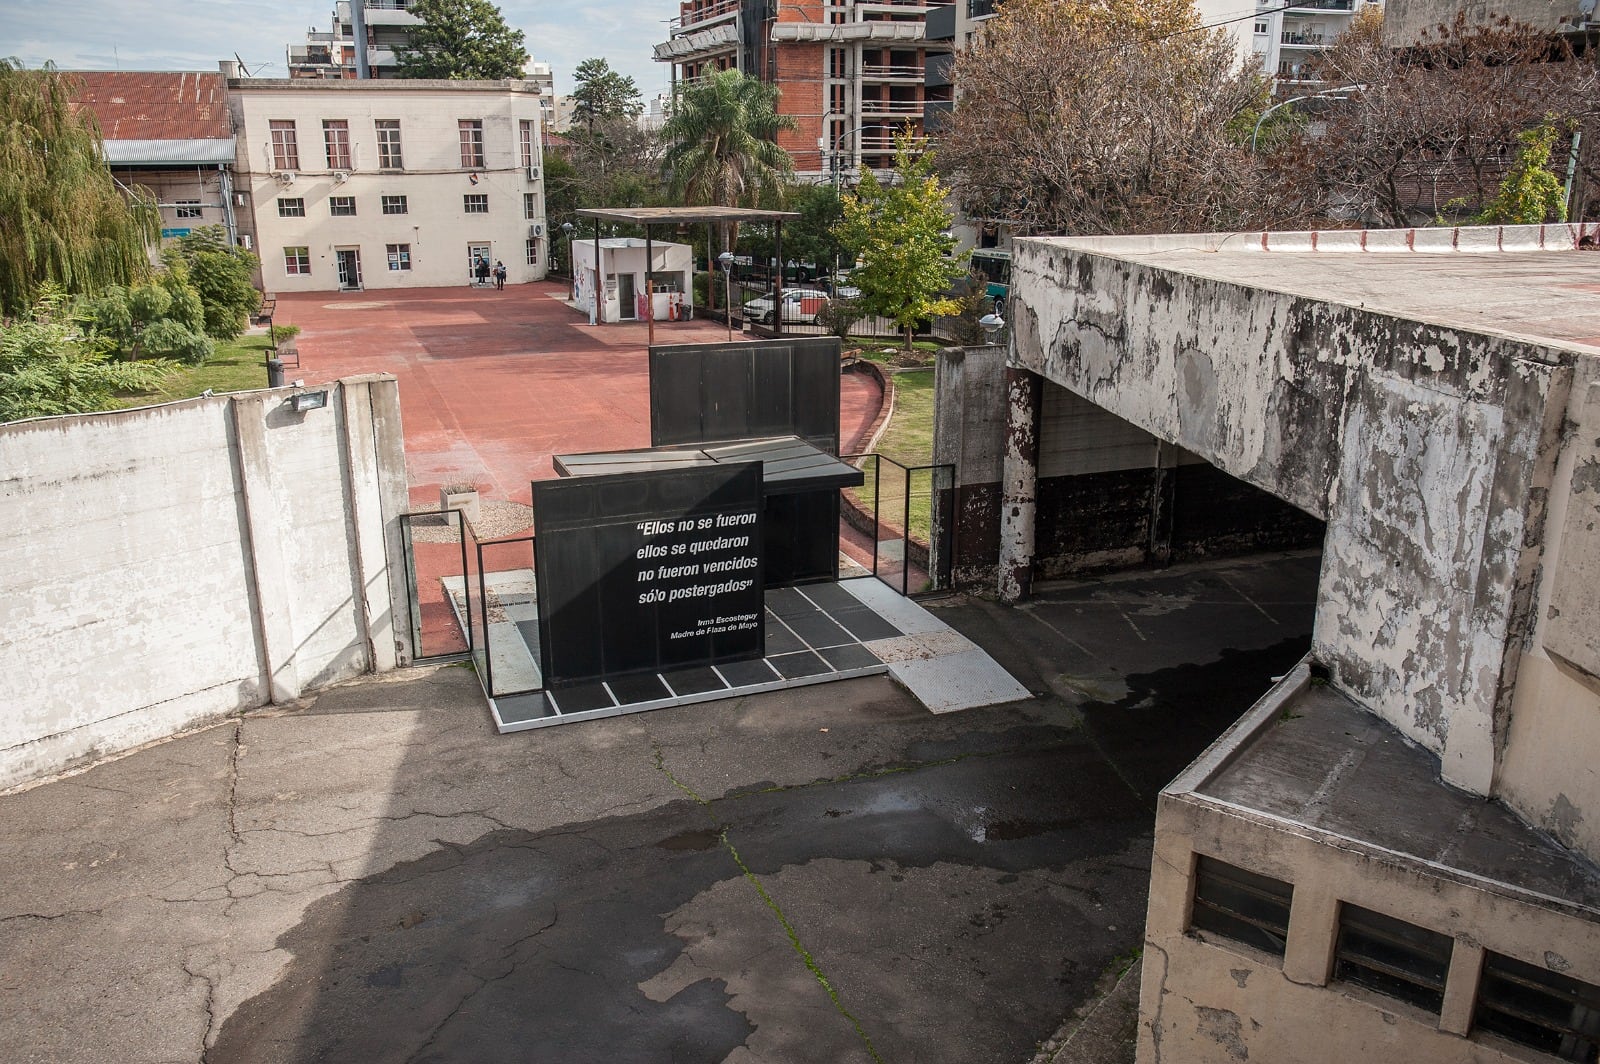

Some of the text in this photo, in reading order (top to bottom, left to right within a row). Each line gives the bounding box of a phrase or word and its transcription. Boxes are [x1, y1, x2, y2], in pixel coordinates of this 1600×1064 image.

[636, 513, 757, 536] “Ellos no se fueron
[636, 536, 749, 559] ellos se quedaron
[637, 556, 758, 582] no fueron vencidos
[638, 579, 753, 604] sólo postergados”
[670, 630, 695, 640] Madre
[696, 628, 706, 636] de
[706, 626, 727, 634] Plaza
[738, 621, 758, 630] Mayo
[697, 613, 758, 627] Irma Escosteguy
